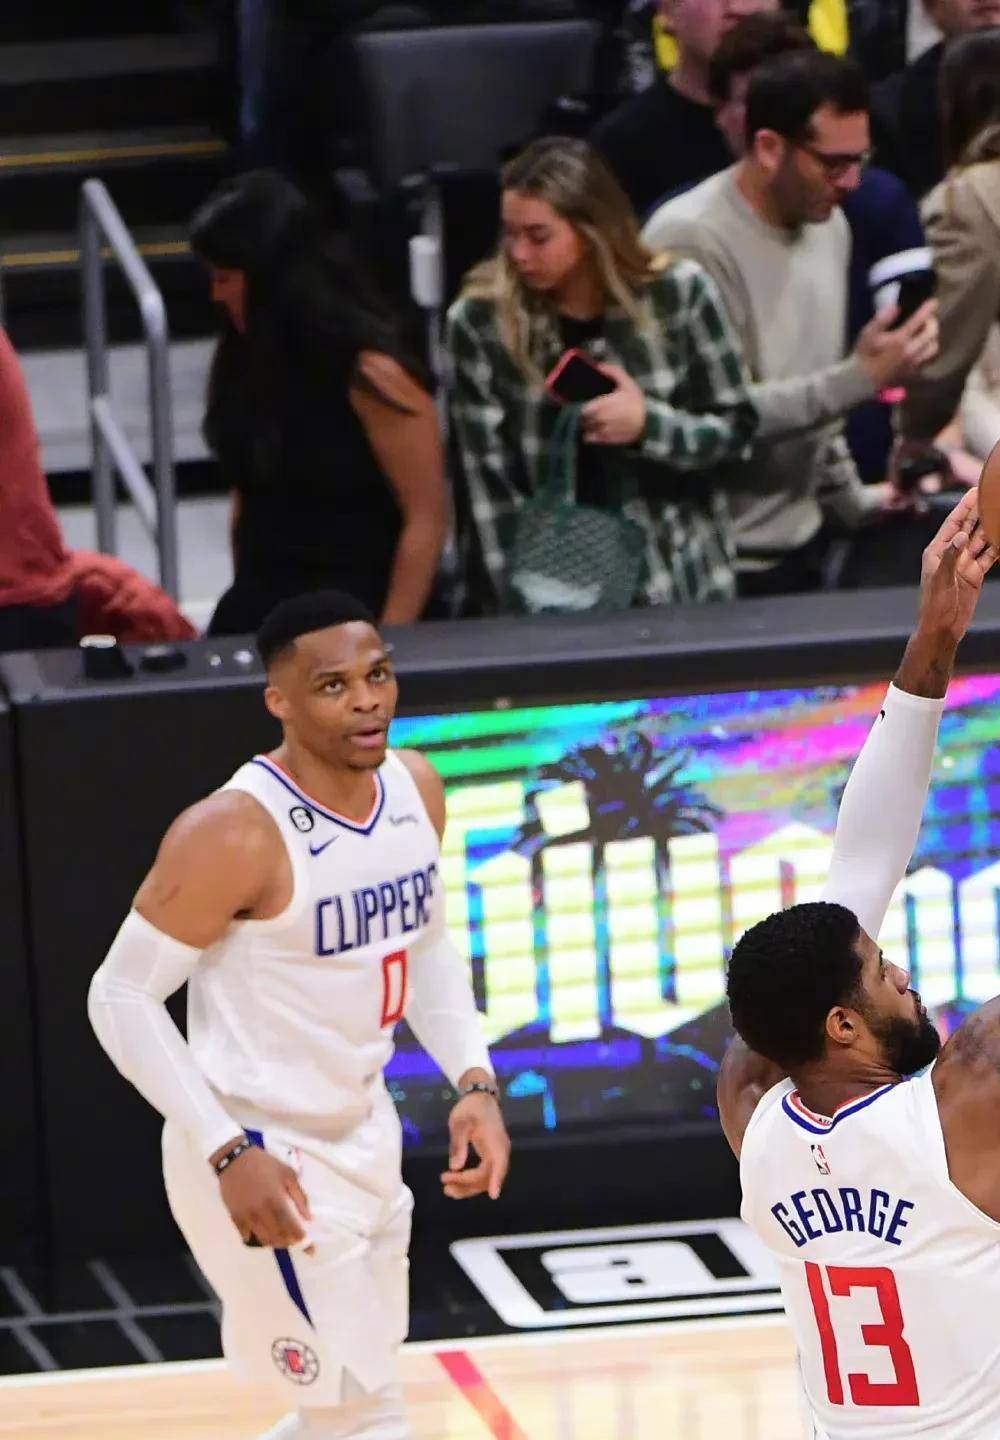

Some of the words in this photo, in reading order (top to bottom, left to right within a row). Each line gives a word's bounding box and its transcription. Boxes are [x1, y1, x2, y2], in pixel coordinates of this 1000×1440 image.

[380, 950, 408, 1029] 0
[771, 1188, 914, 1248] GEORGE
[805, 1261, 920, 1406] 13
